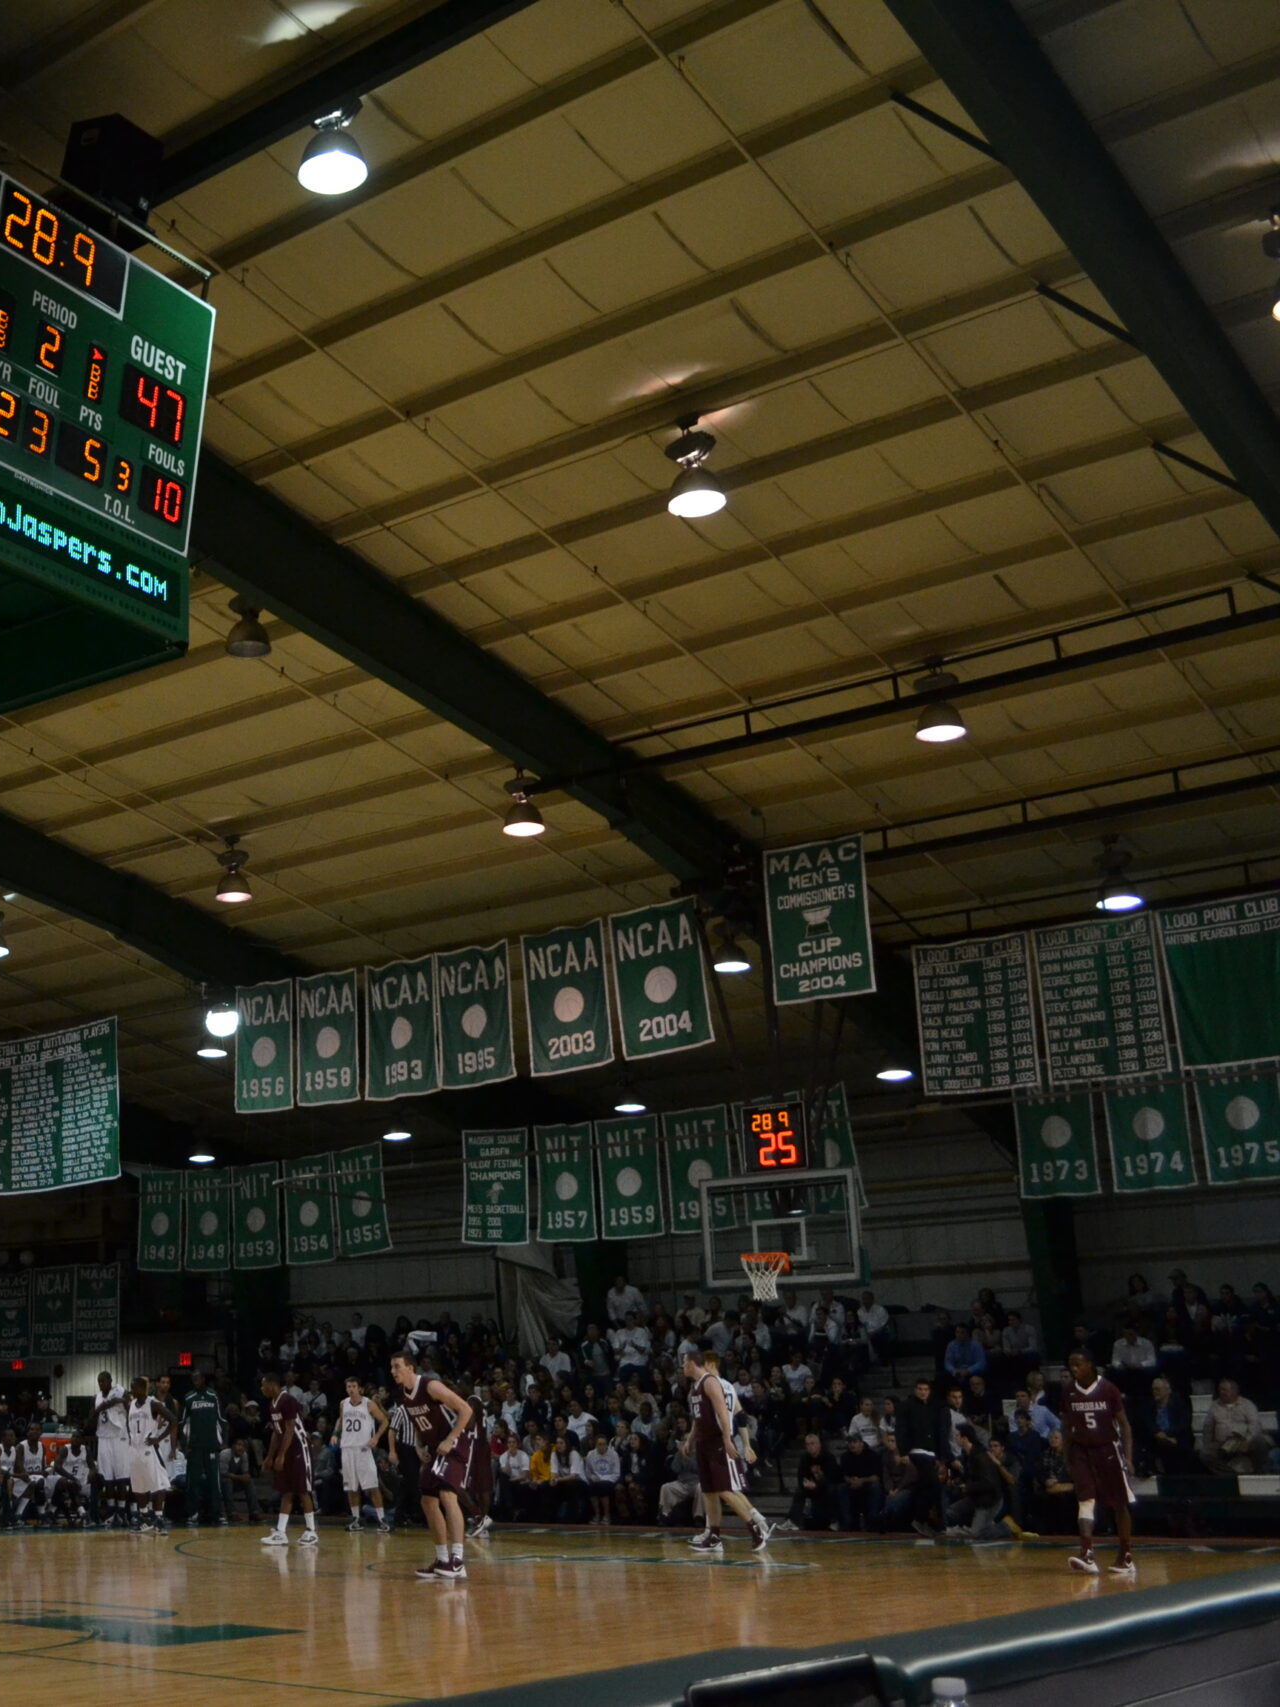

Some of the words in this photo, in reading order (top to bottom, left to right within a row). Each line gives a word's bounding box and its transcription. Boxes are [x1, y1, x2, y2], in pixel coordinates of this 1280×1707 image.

[3, 191, 97, 288] 28.9
[32, 289, 78, 330] PERIOD
[39, 324, 64, 371] 2
[130, 334, 188, 386] GUEST
[28, 376, 61, 410] FOUL
[79, 404, 103, 433] PTS
[136, 375, 187, 444] 47
[28, 408, 51, 455] 3
[82, 437, 103, 484] 5
[147, 443, 186, 478] FOULS
[116, 459, 131, 493] 3
[103, 492, 136, 526] T.O.L.
[153, 475, 184, 525] 10
[770, 841, 858, 875] MAAC
[788, 867, 840, 891] MEN'S
[777, 883, 856, 911] COMMISSIONER'S
[1202, 904, 1237, 925] POINT
[1243, 896, 1279, 918] CLUB
[617, 913, 694, 962] NCAA
[1073, 924, 1108, 942] POINT
[1115, 918, 1147, 937] CLUB
[1200, 925, 1238, 942] PEARSON
[529, 936, 599, 981] NCAA
[798, 936, 842, 957] CUP
[954, 943, 986, 961] POINT
[992, 936, 1023, 957] CLUB
[440, 956, 506, 998] NCAA
[780, 952, 863, 979] CHAMPIONS
[372, 970, 431, 1011] NCAA
[798, 973, 846, 993] 2004
[239, 994, 290, 1027] NCAA
[300, 981, 355, 1019] NCAA
[639, 1009, 693, 1042] 2004
[19, 1053, 38, 1065] 100
[39, 1044, 82, 1062] SEASONS
[548, 1029, 596, 1061] 2003
[385, 1058, 423, 1086] 1993
[457, 1046, 496, 1075] 1995
[241, 1075, 285, 1099] 1956
[305, 1066, 351, 1092] 1958
[545, 1135, 582, 1164] NIT
[606, 1127, 646, 1159] NIT
[675, 1119, 716, 1152] NIT
[759, 1129, 798, 1168] 25
[479, 1147, 511, 1157] GARDEN
[493, 1158, 523, 1168] FESTIVAL
[1123, 1149, 1185, 1177] 1974
[1216, 1139, 1280, 1169] 1975
[291, 1164, 323, 1194] NIT
[341, 1154, 374, 1185] NIT
[470, 1171, 521, 1181] CHAMPIONS
[1029, 1158, 1089, 1183] 1973
[146, 1180, 176, 1205] NIT
[193, 1178, 221, 1204] NIT
[240, 1172, 270, 1200] NIT
[485, 1203, 525, 1214] BASKETBALL
[546, 1210, 588, 1230] 1957
[610, 1204, 656, 1227] 1959
[292, 1233, 329, 1253] 1954
[345, 1221, 382, 1245] 1955
[192, 1243, 225, 1260] 1949
[239, 1239, 275, 1258] 1953
[36, 1271, 71, 1297] NCAA
[79, 1266, 115, 1281] MAAC
[0, 1326, 21, 1338] CUP
[40, 1337, 67, 1352] 2002
[101, 1410, 109, 1425] 3
[1071, 1399, 1108, 1412] FORDHAM
[135, 1419, 141, 1434] 1
[345, 1418, 362, 1433] 20
[415, 1415, 433, 1432] 10
[1084, 1412, 1097, 1430] 5
